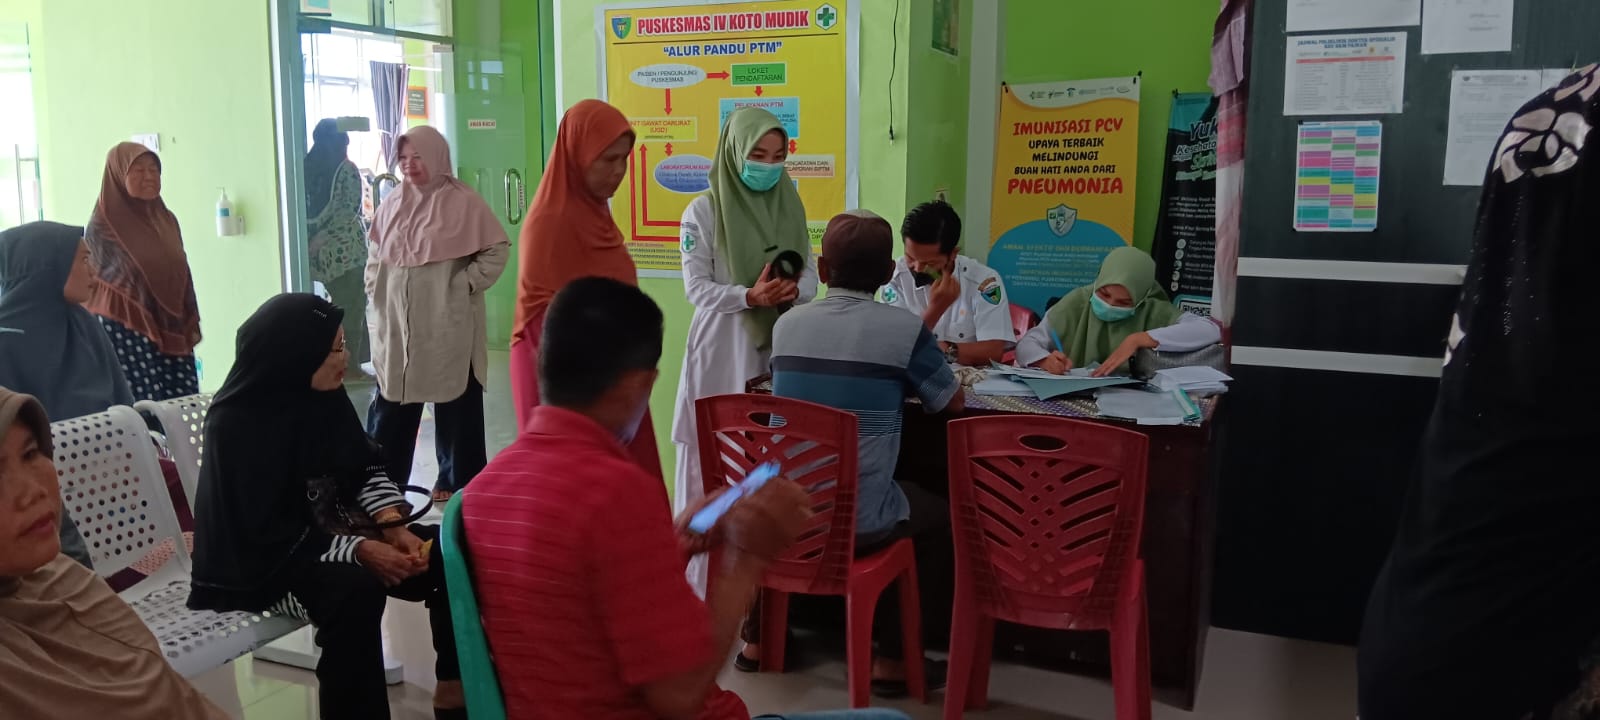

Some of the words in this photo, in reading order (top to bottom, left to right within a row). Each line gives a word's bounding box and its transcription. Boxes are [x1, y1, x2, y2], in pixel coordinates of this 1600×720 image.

[637, 15, 711, 35] PUSKESMAS
[713, 16, 726, 31] IV
[729, 13, 762, 31] KOTO
[765, 11, 809, 29] MUDIK
[704, 43, 746, 55] PANDU
[1013, 119, 1091, 136] IMUNISASI
[1095, 118, 1124, 133] PCV
[1028, 139, 1060, 149] UPAYA
[1062, 137, 1104, 148] TERBAIK
[1032, 151, 1099, 161] MELINDUNGI
[1014, 166, 1039, 175] BUAH
[1041, 166, 1061, 175] HATI
[1063, 165, 1090, 174] ANDA
[1092, 165, 1116, 174] DARI
[1007, 177, 1124, 195] PNEUMONIA
